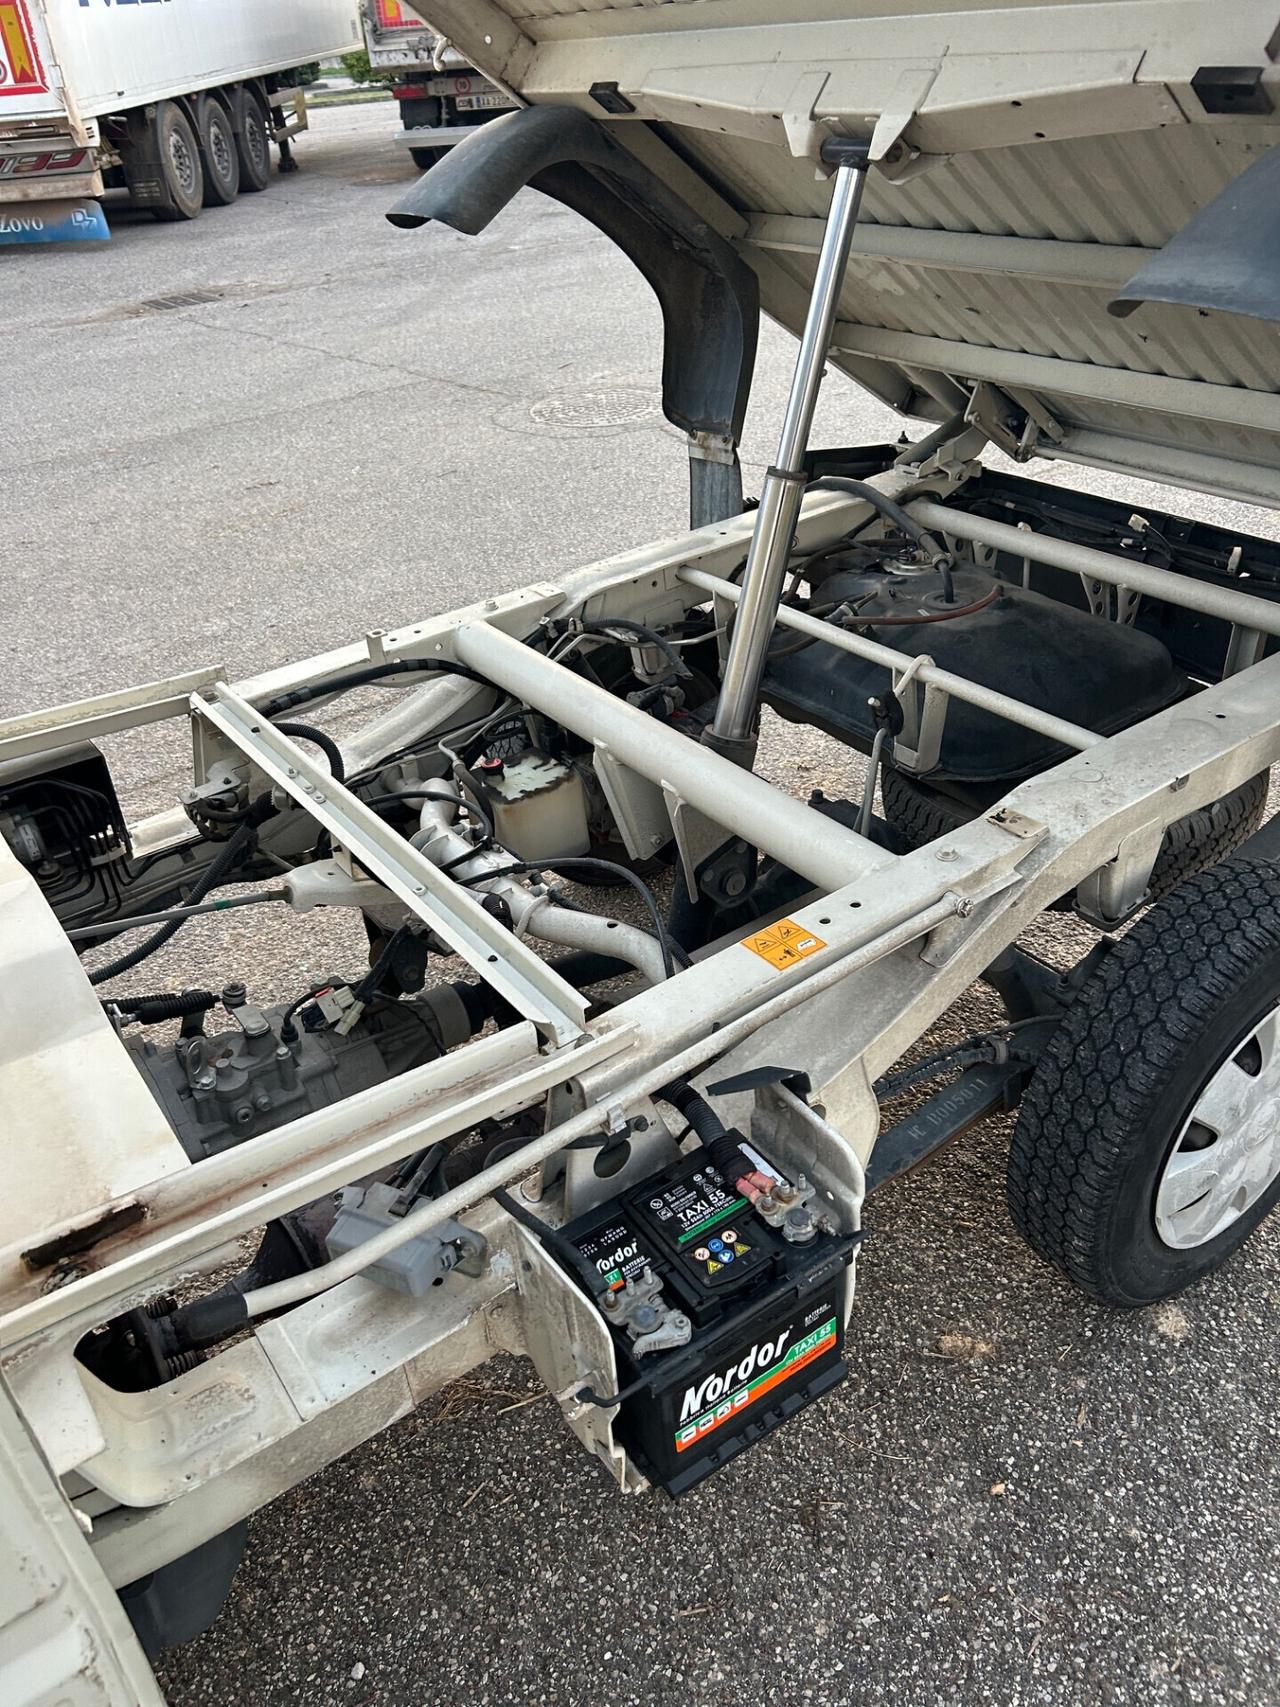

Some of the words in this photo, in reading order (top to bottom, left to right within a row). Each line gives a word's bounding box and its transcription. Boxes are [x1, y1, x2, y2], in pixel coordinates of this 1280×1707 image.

[677, 1200, 709, 1222] TAXI
[708, 1189, 726, 1204] 55
[794, 1335, 818, 1355] TAXI
[820, 1323, 832, 1338] 55
[679, 1329, 790, 1422] Nordor
